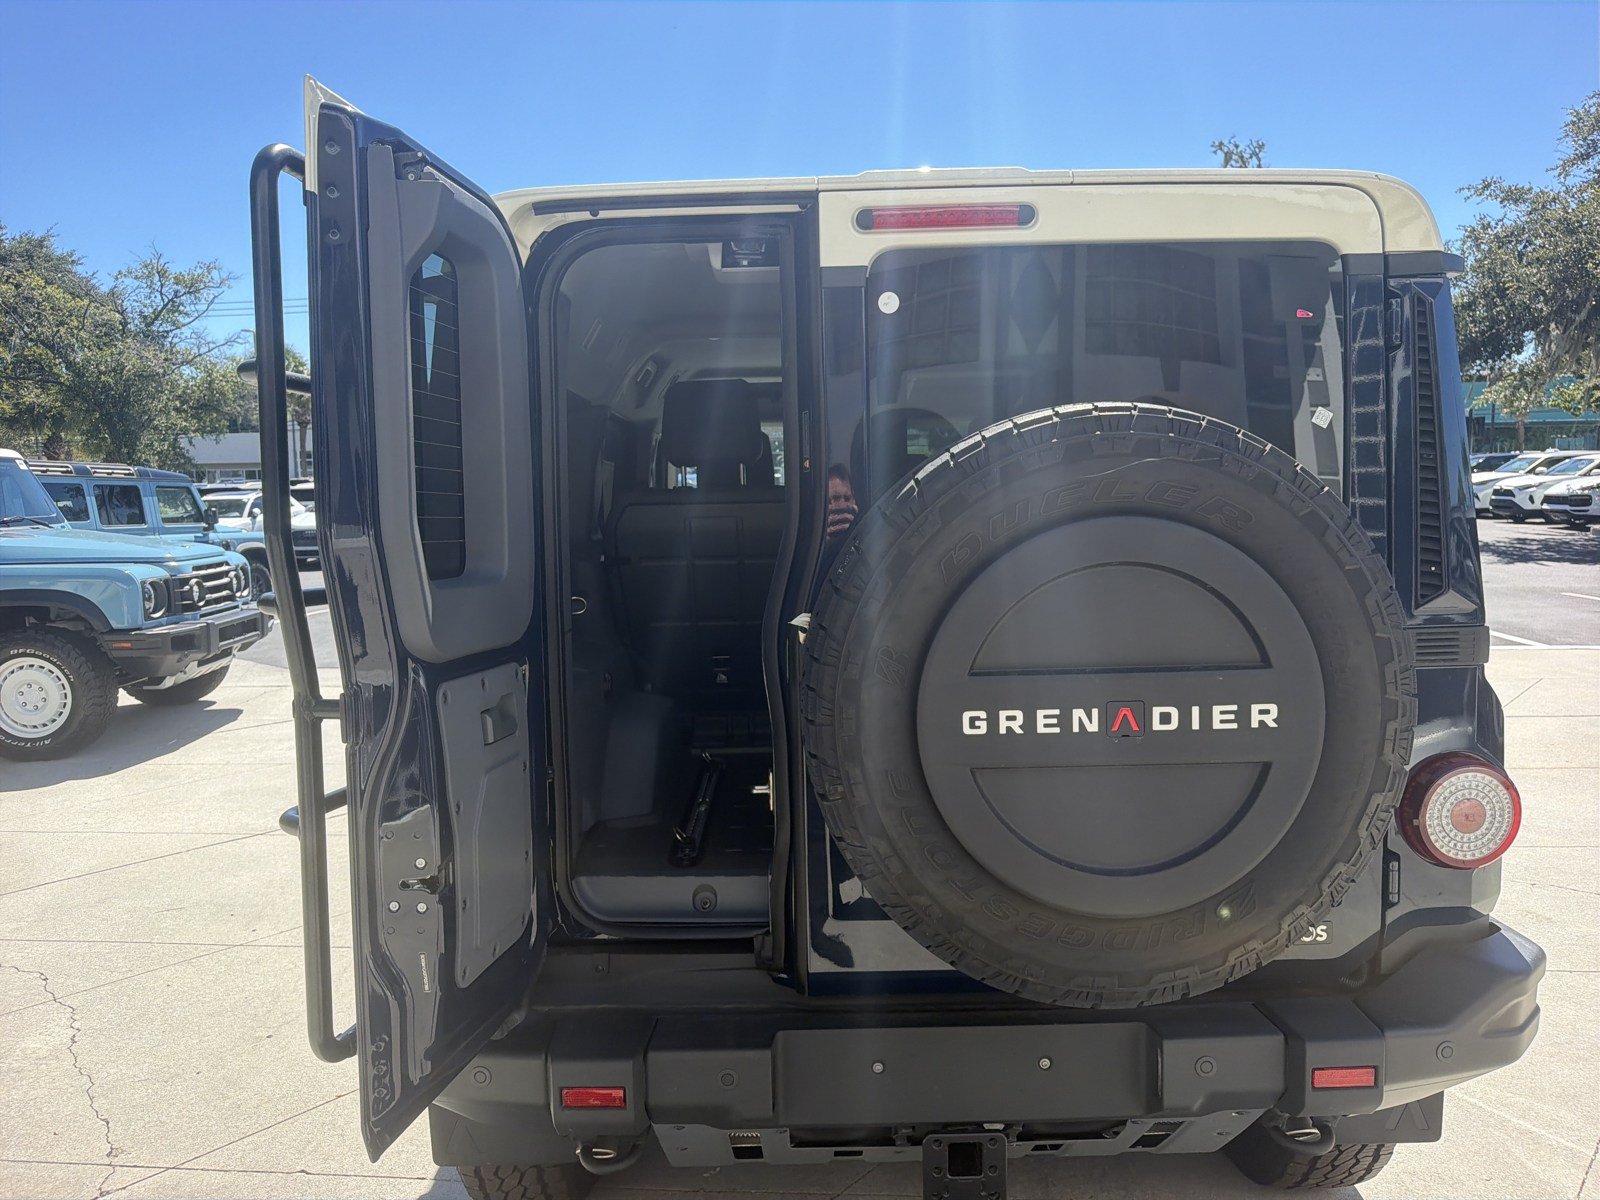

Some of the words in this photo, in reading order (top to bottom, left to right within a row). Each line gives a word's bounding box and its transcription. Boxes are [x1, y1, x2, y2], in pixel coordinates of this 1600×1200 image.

[938, 479, 1255, 584] DUELER
[10, 648, 74, 682] BFGoodrich
[961, 703, 1279, 735] GRENADIER
